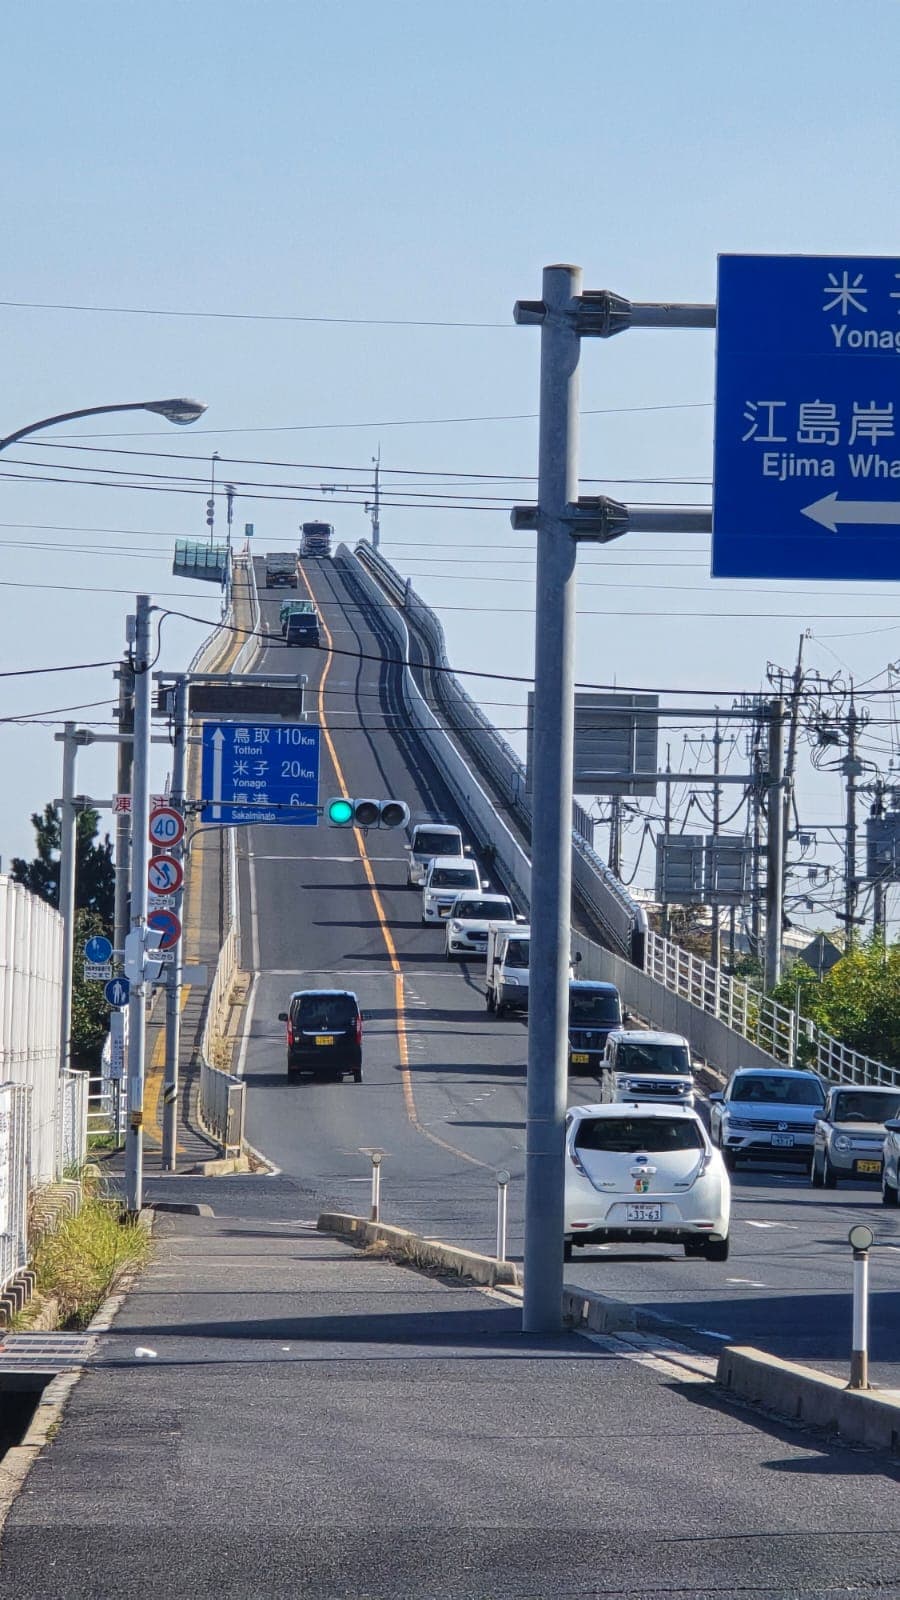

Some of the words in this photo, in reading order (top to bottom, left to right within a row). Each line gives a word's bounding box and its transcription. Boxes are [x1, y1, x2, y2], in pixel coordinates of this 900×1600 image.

[822, 271, 900, 316] 米
[742, 399, 895, 446] 江島岸
[763, 453, 835, 481] Ejima
[233, 728, 270, 743] 鳥取
[233, 745, 262, 755] Tottori
[233, 760, 269, 776] 米子
[232, 778, 267, 789] Yonago
[154, 819, 175, 836] 40
